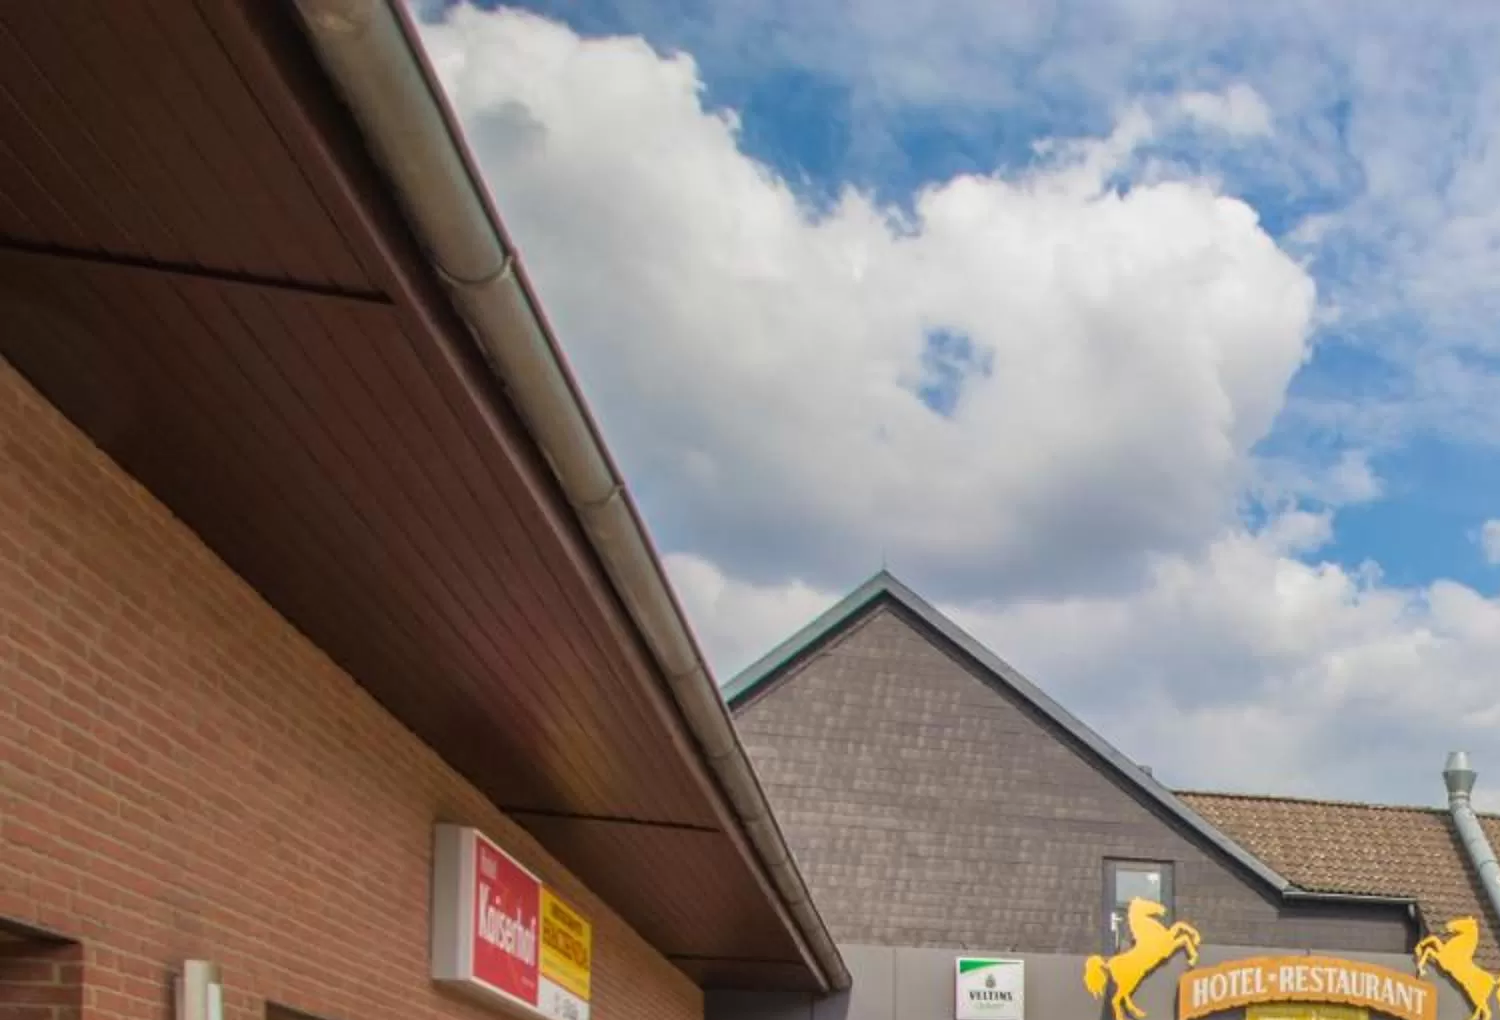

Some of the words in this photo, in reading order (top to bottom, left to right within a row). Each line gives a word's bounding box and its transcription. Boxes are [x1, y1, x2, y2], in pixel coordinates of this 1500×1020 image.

[479, 882, 536, 966] Kaiserhof
[1193, 966, 1267, 1008] HOTEL
[1279, 965, 1428, 1015] RESTAURANT
